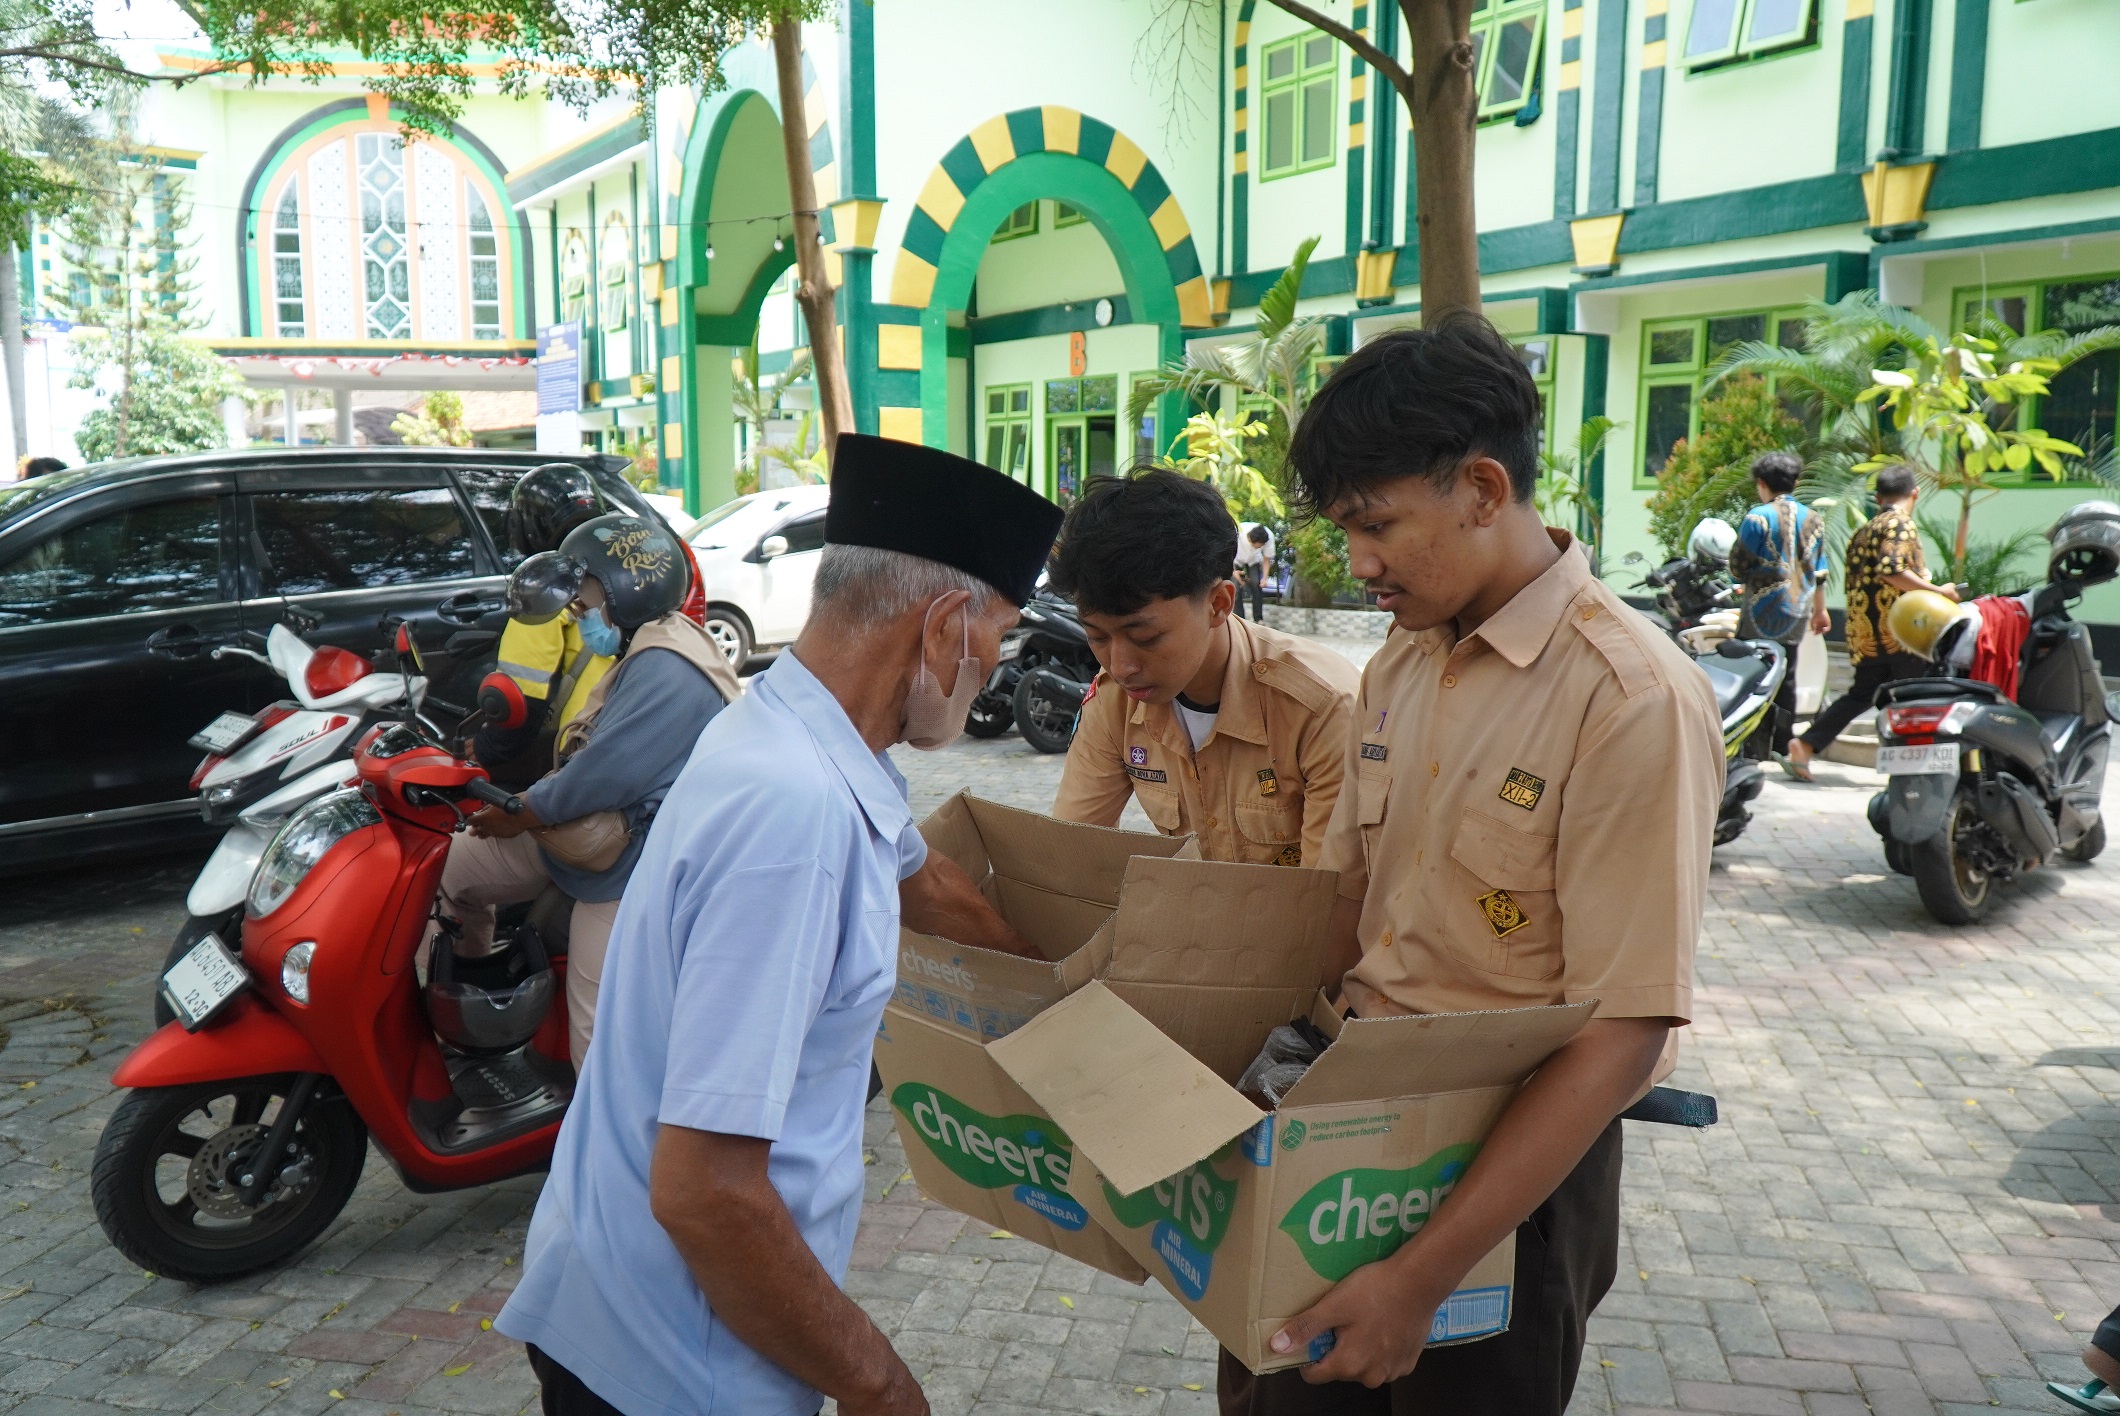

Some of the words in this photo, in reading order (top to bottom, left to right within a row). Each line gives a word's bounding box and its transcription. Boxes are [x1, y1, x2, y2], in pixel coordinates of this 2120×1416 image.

[1070, 331, 1086, 376] B
[606, 527, 654, 558] Born
[1503, 783, 1537, 807] XII-2
[902, 946, 976, 992] cheers
[1309, 1131, 1334, 1141] reduce
[1334, 1129, 1359, 1140] carbon
[1310, 1122, 1330, 1131] Using
[1331, 1116, 1368, 1128] renewable
[1369, 1114, 1392, 1124] energy
[1393, 1112, 1401, 1121] to
[912, 1091, 1070, 1193] cheers
[1025, 1196, 1081, 1224] MINERAL
[1031, 1190, 1047, 1203] AIR
[1309, 1177, 1455, 1245] cheer
[1168, 1229, 1182, 1249] AIR
[1161, 1239, 1202, 1290] MINERAL
